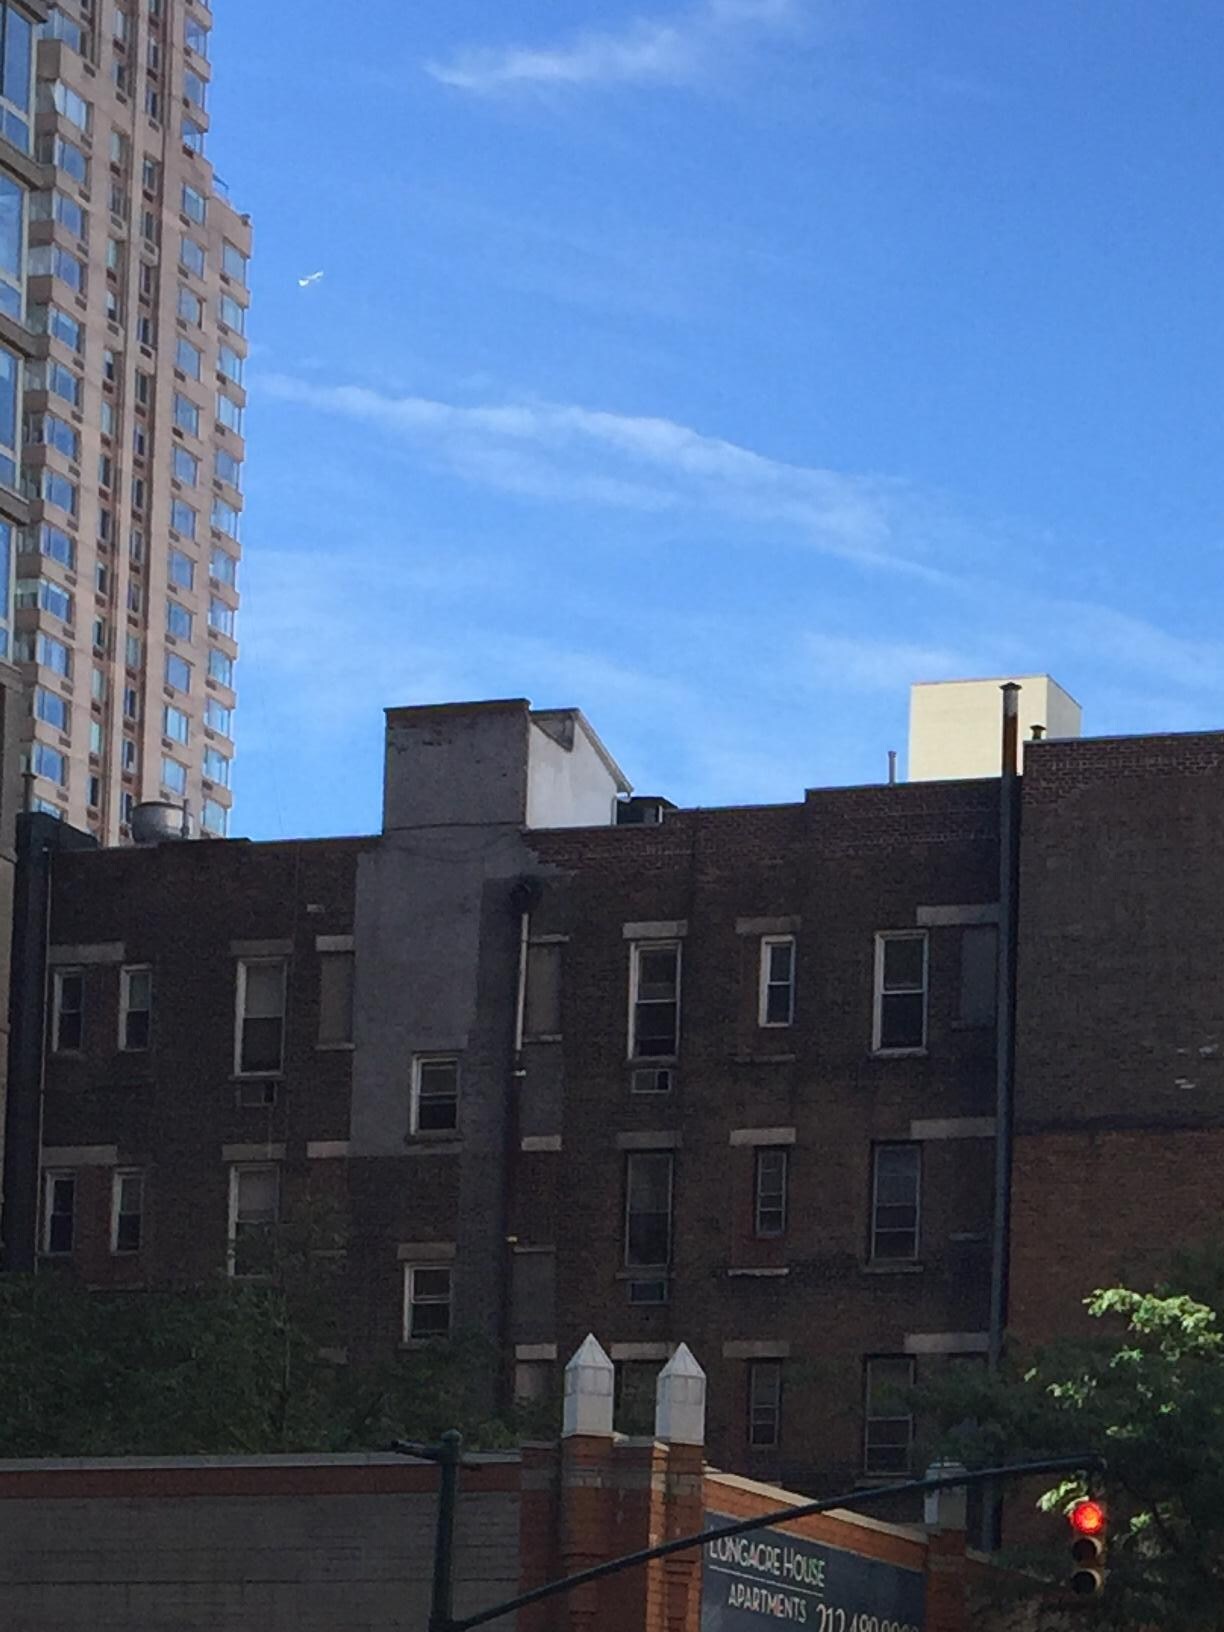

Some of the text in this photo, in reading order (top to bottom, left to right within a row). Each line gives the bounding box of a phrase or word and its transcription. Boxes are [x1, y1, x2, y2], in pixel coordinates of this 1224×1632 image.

[708, 1530, 826, 1588] LONGACRE HOUSE
[728, 1583, 807, 1624] APARTMENTS
